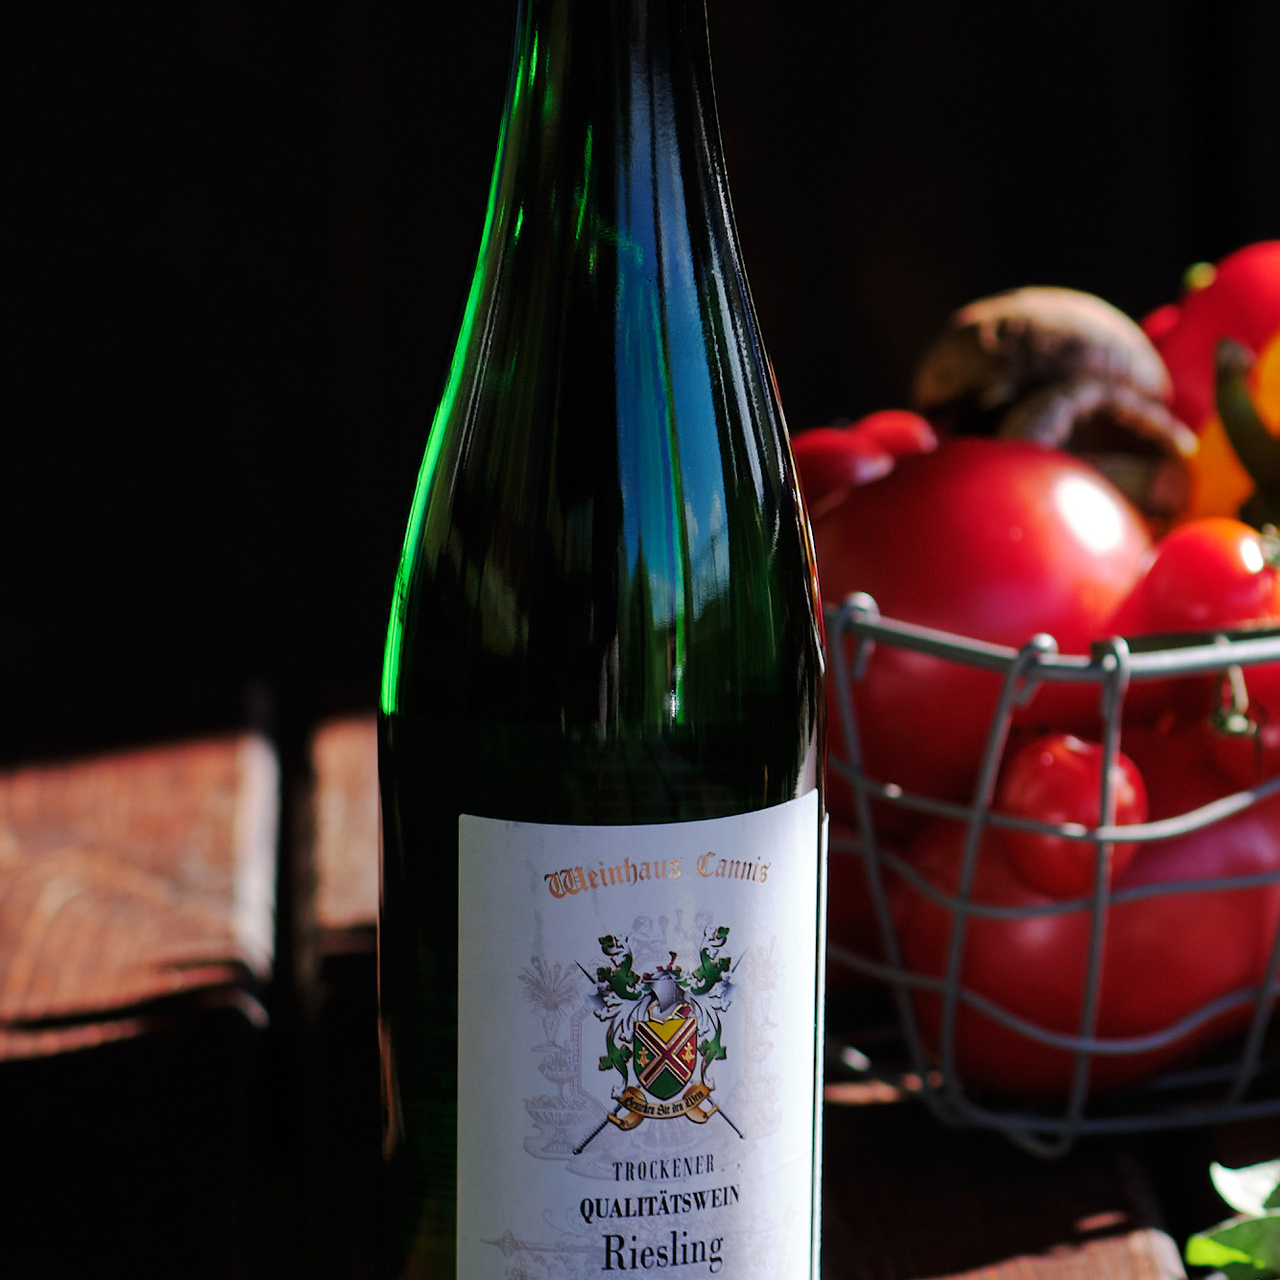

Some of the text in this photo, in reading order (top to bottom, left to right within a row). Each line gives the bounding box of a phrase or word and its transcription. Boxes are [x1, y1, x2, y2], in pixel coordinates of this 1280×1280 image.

[544, 851, 771, 899] Weinhaus Cannis
[612, 1153, 714, 1181] TROCKENER
[580, 1184, 741, 1224] QUALITÄTSWEIN
[601, 1230, 723, 1273] Riesling
